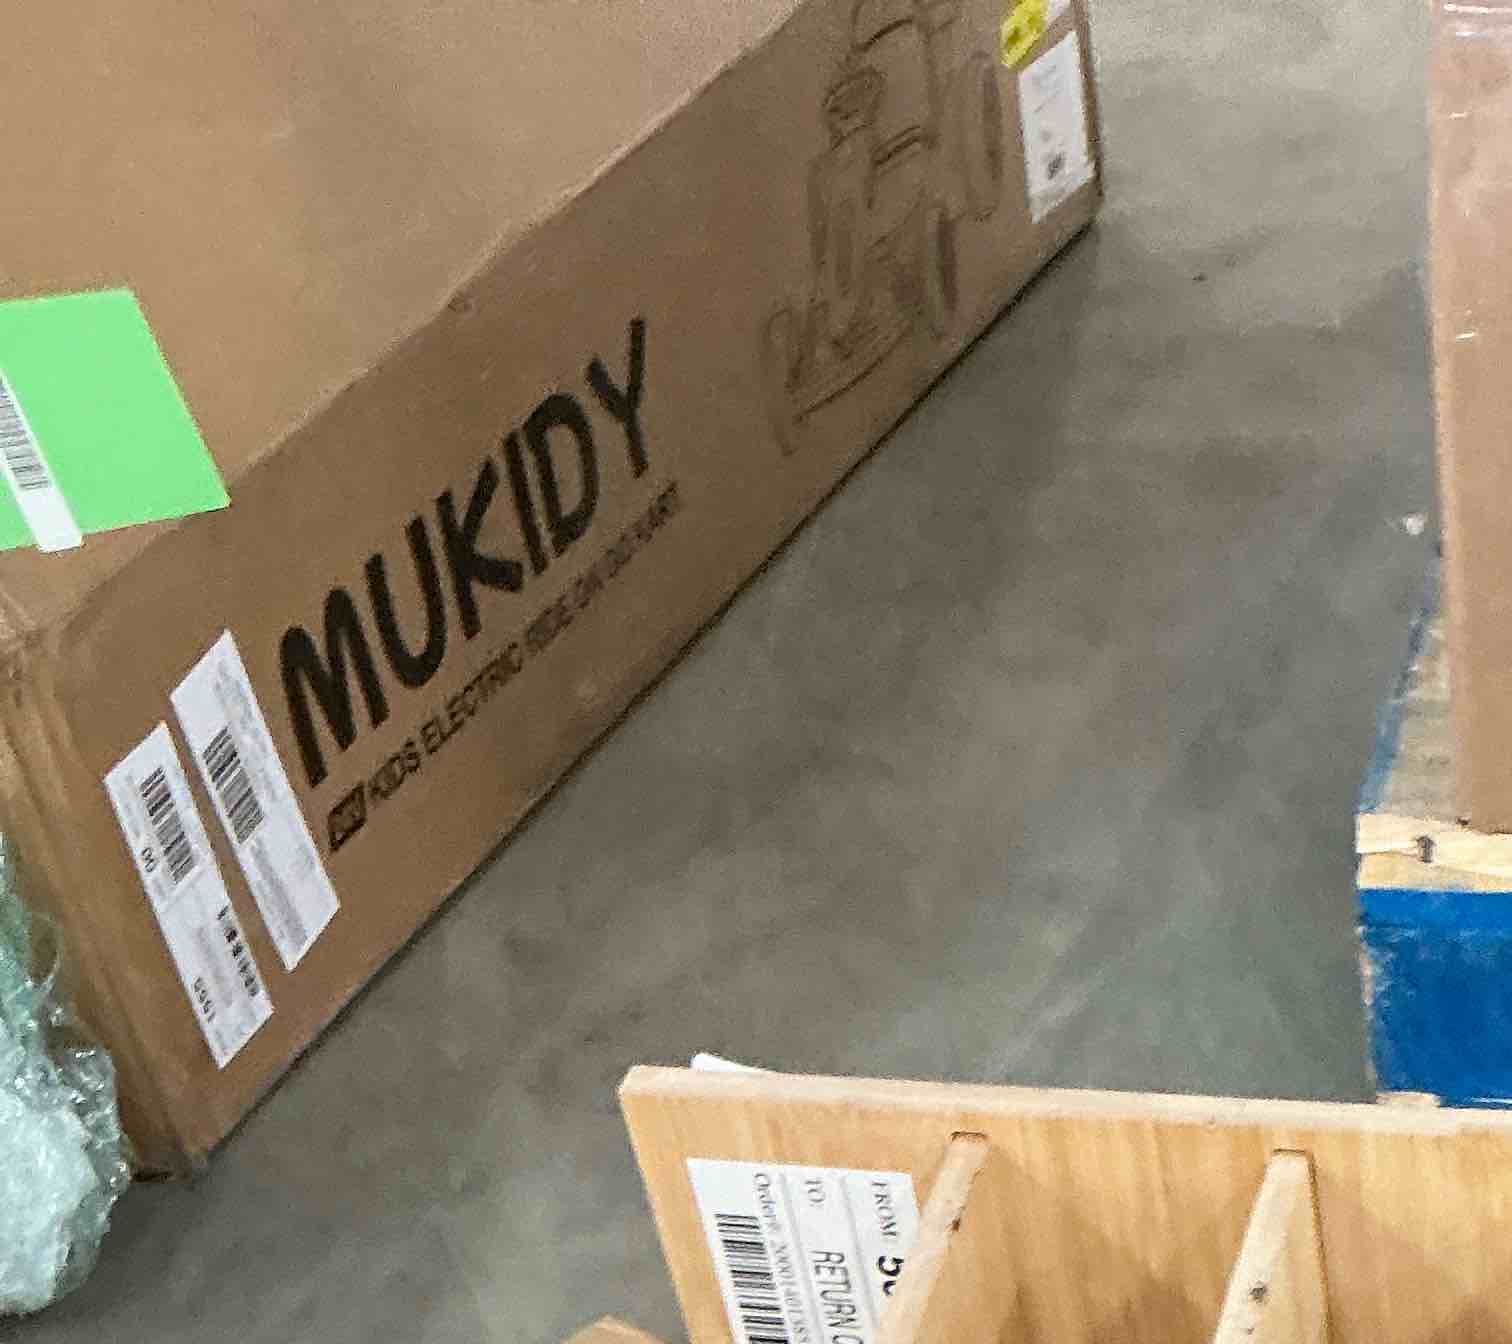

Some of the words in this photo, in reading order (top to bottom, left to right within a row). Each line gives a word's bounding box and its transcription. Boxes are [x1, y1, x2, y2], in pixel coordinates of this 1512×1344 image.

[279, 317, 649, 787] MUKIDY
[419, 641, 524, 755] ELECTRIC
[810, 1250, 862, 1329] RETURN
[876, 1255, 905, 1297] 5
